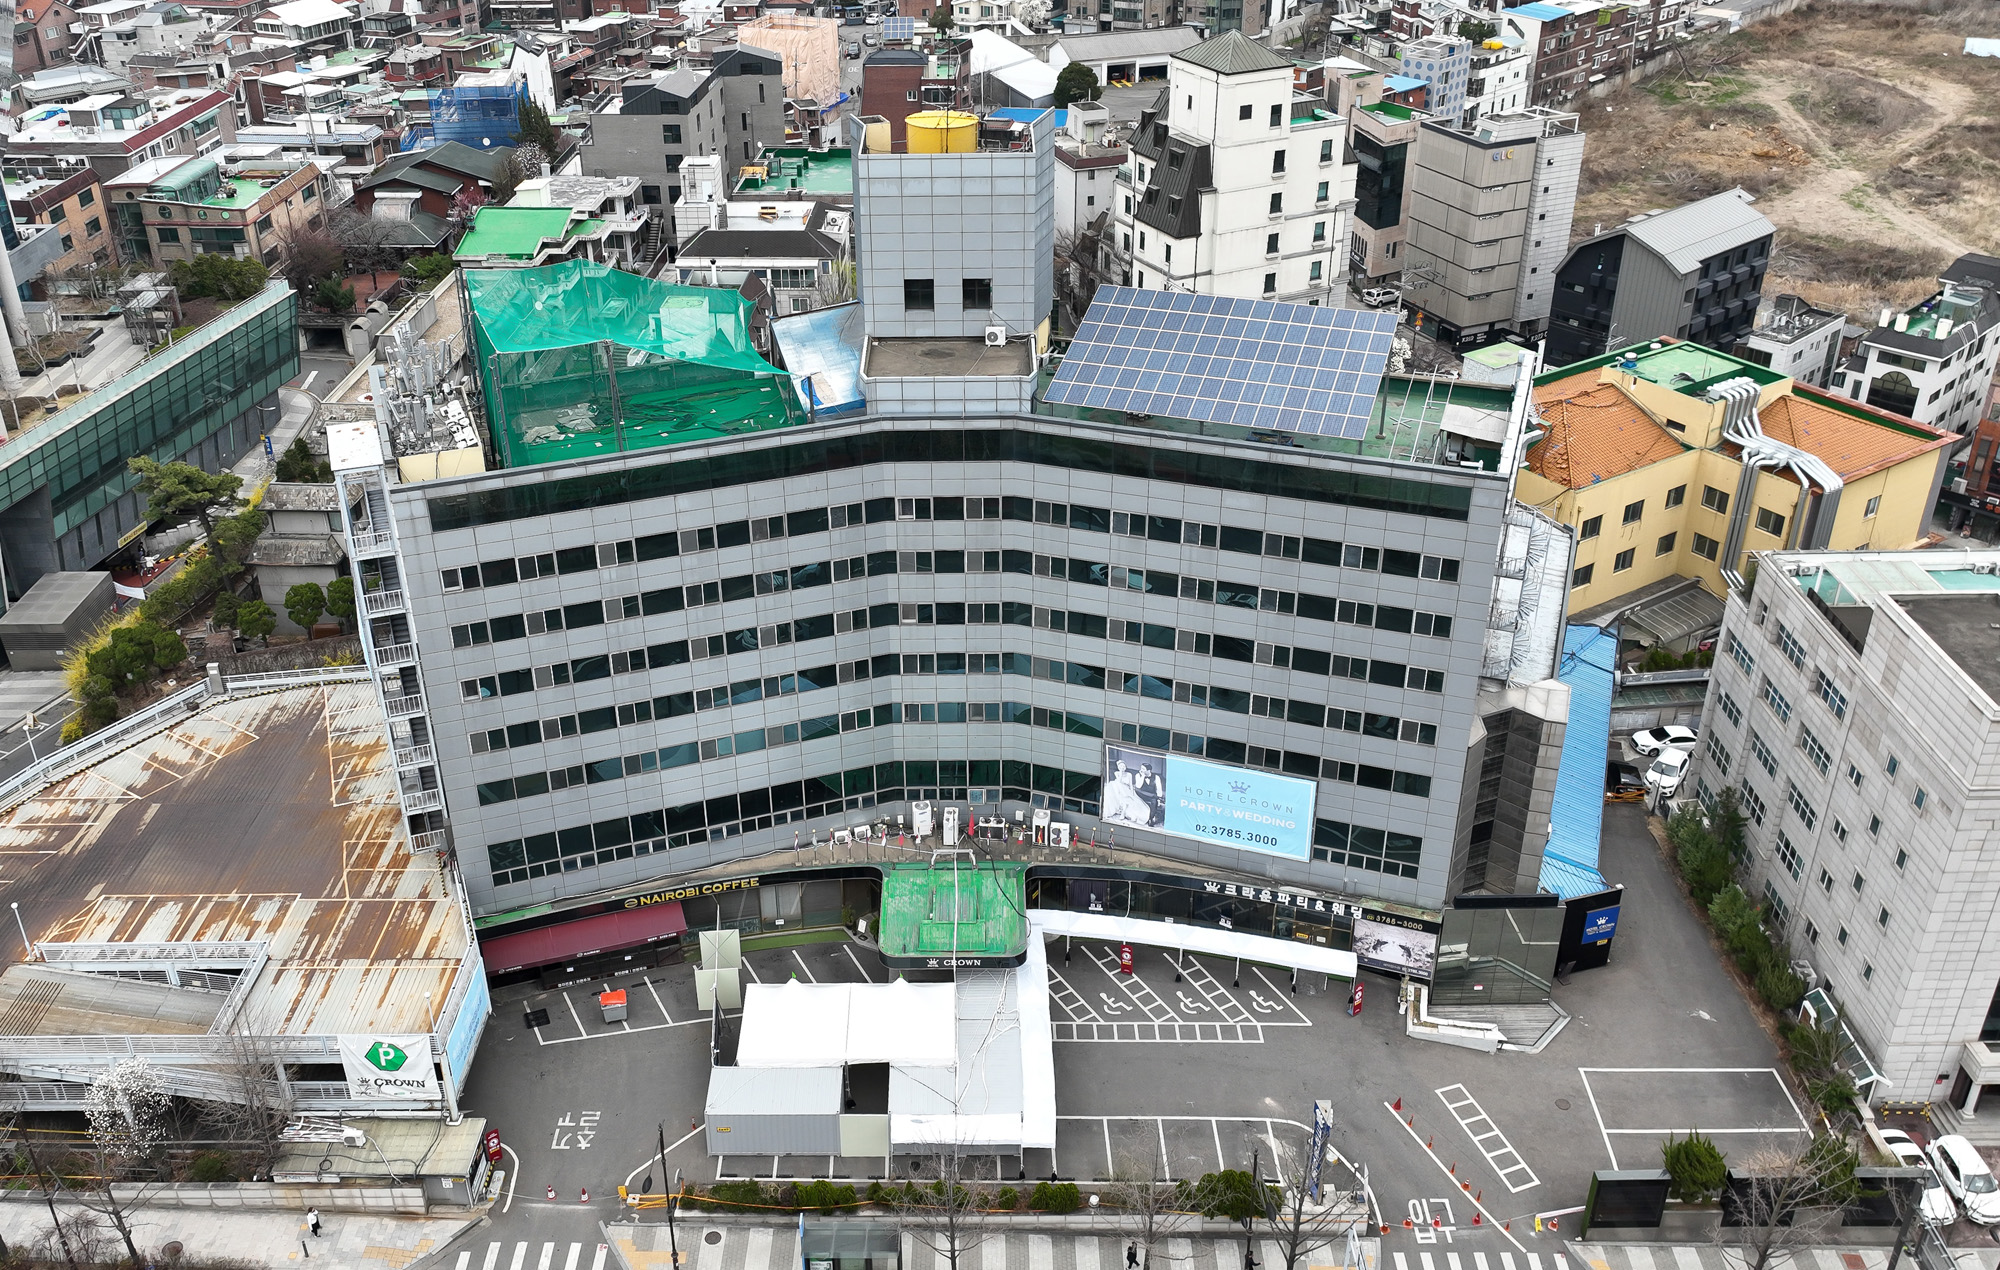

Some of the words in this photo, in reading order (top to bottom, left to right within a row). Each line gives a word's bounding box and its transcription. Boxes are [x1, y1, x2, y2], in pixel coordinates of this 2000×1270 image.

[1492, 149, 1514, 161] GLC
[1185, 785, 1233, 802] HOTEL
[1239, 796, 1294, 814] CROWN
[1195, 823, 1278, 847] 02.3785.3000
[640, 886, 700, 906] NAIROBI
[702, 877, 760, 894] COFFEE
[1375, 914, 1424, 931] 3785-3000
[377, 1046, 395, 1067] P
[373, 1078, 426, 1089] CROWN
[1407, 1198, 1457, 1244] 입구
